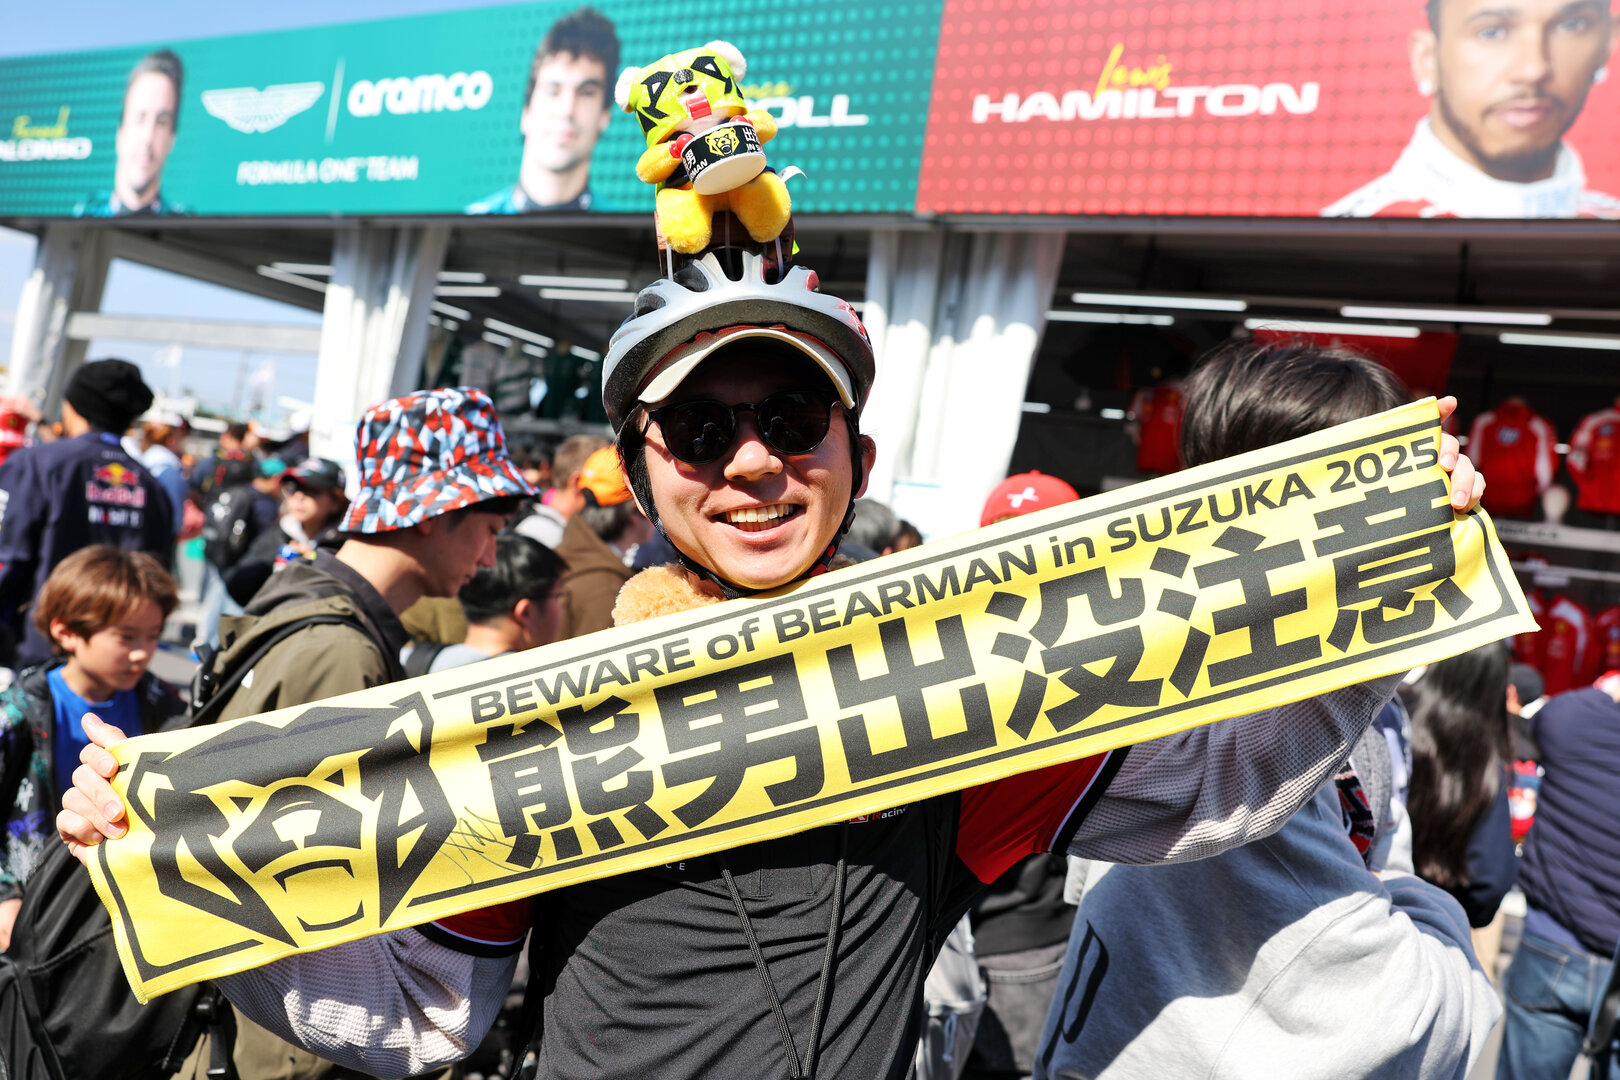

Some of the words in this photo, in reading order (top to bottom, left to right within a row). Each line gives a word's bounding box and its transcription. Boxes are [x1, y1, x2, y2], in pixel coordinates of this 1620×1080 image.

[347, 70, 493, 117] aramco
[971, 82, 1320, 123] HAMILTON
[0, 137, 92, 161] LONSO
[236, 159, 318, 185] FORMULA
[367, 155, 419, 181] TEAM
[471, 638, 695, 725] BEWARE
[706, 618, 760, 661] of
[773, 544, 1038, 644] BEARMAN
[1049, 536, 1097, 569] in
[1107, 472, 1316, 553] SUZUKA
[1326, 436, 1438, 493] 2025
[474, 479, 1473, 869] 熊男出没注意
